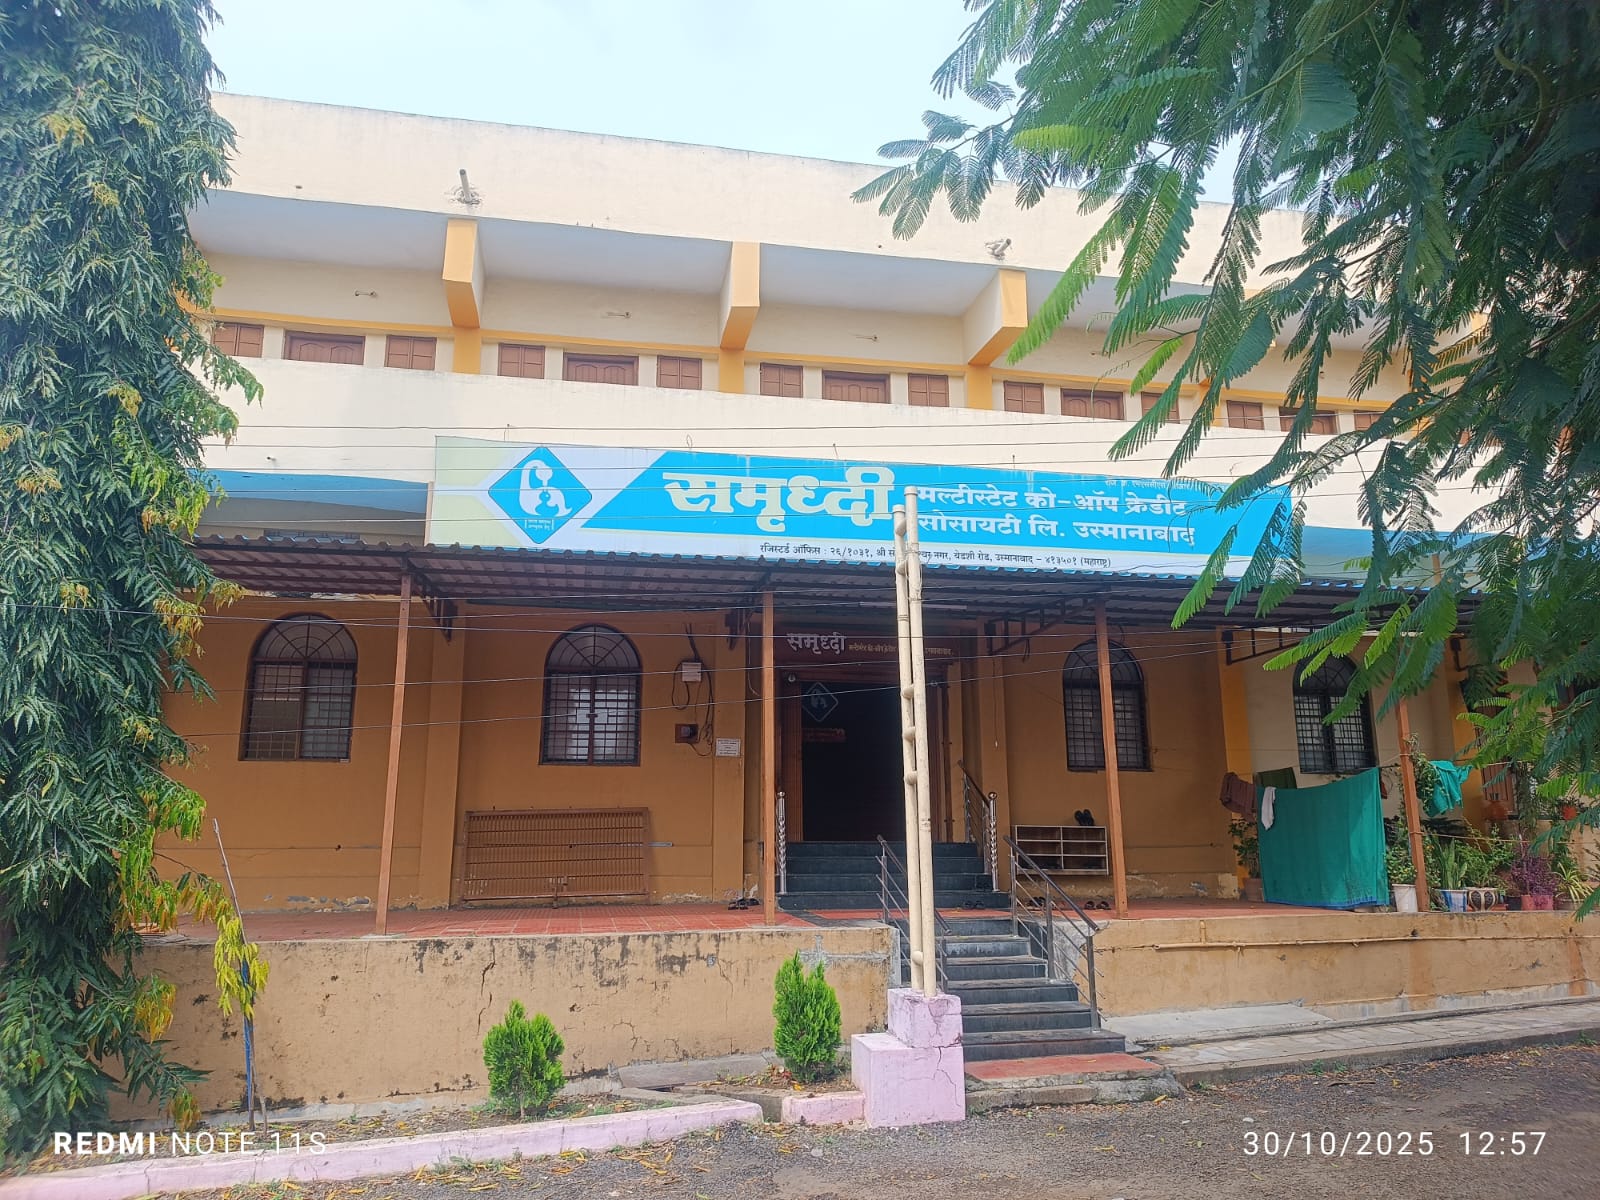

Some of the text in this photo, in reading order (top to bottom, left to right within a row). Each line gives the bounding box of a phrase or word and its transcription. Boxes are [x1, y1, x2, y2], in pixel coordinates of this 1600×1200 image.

[917, 484, 1018, 507] मल्टीस्टेट
[1125, 492, 1187, 516] क्रेडीट
[917, 509, 1195, 547] सोसायटी लि. उस्मानाबाद
[978, 550, 992, 562] रोड,
[995, 553, 1034, 564] उस्मानाबाद
